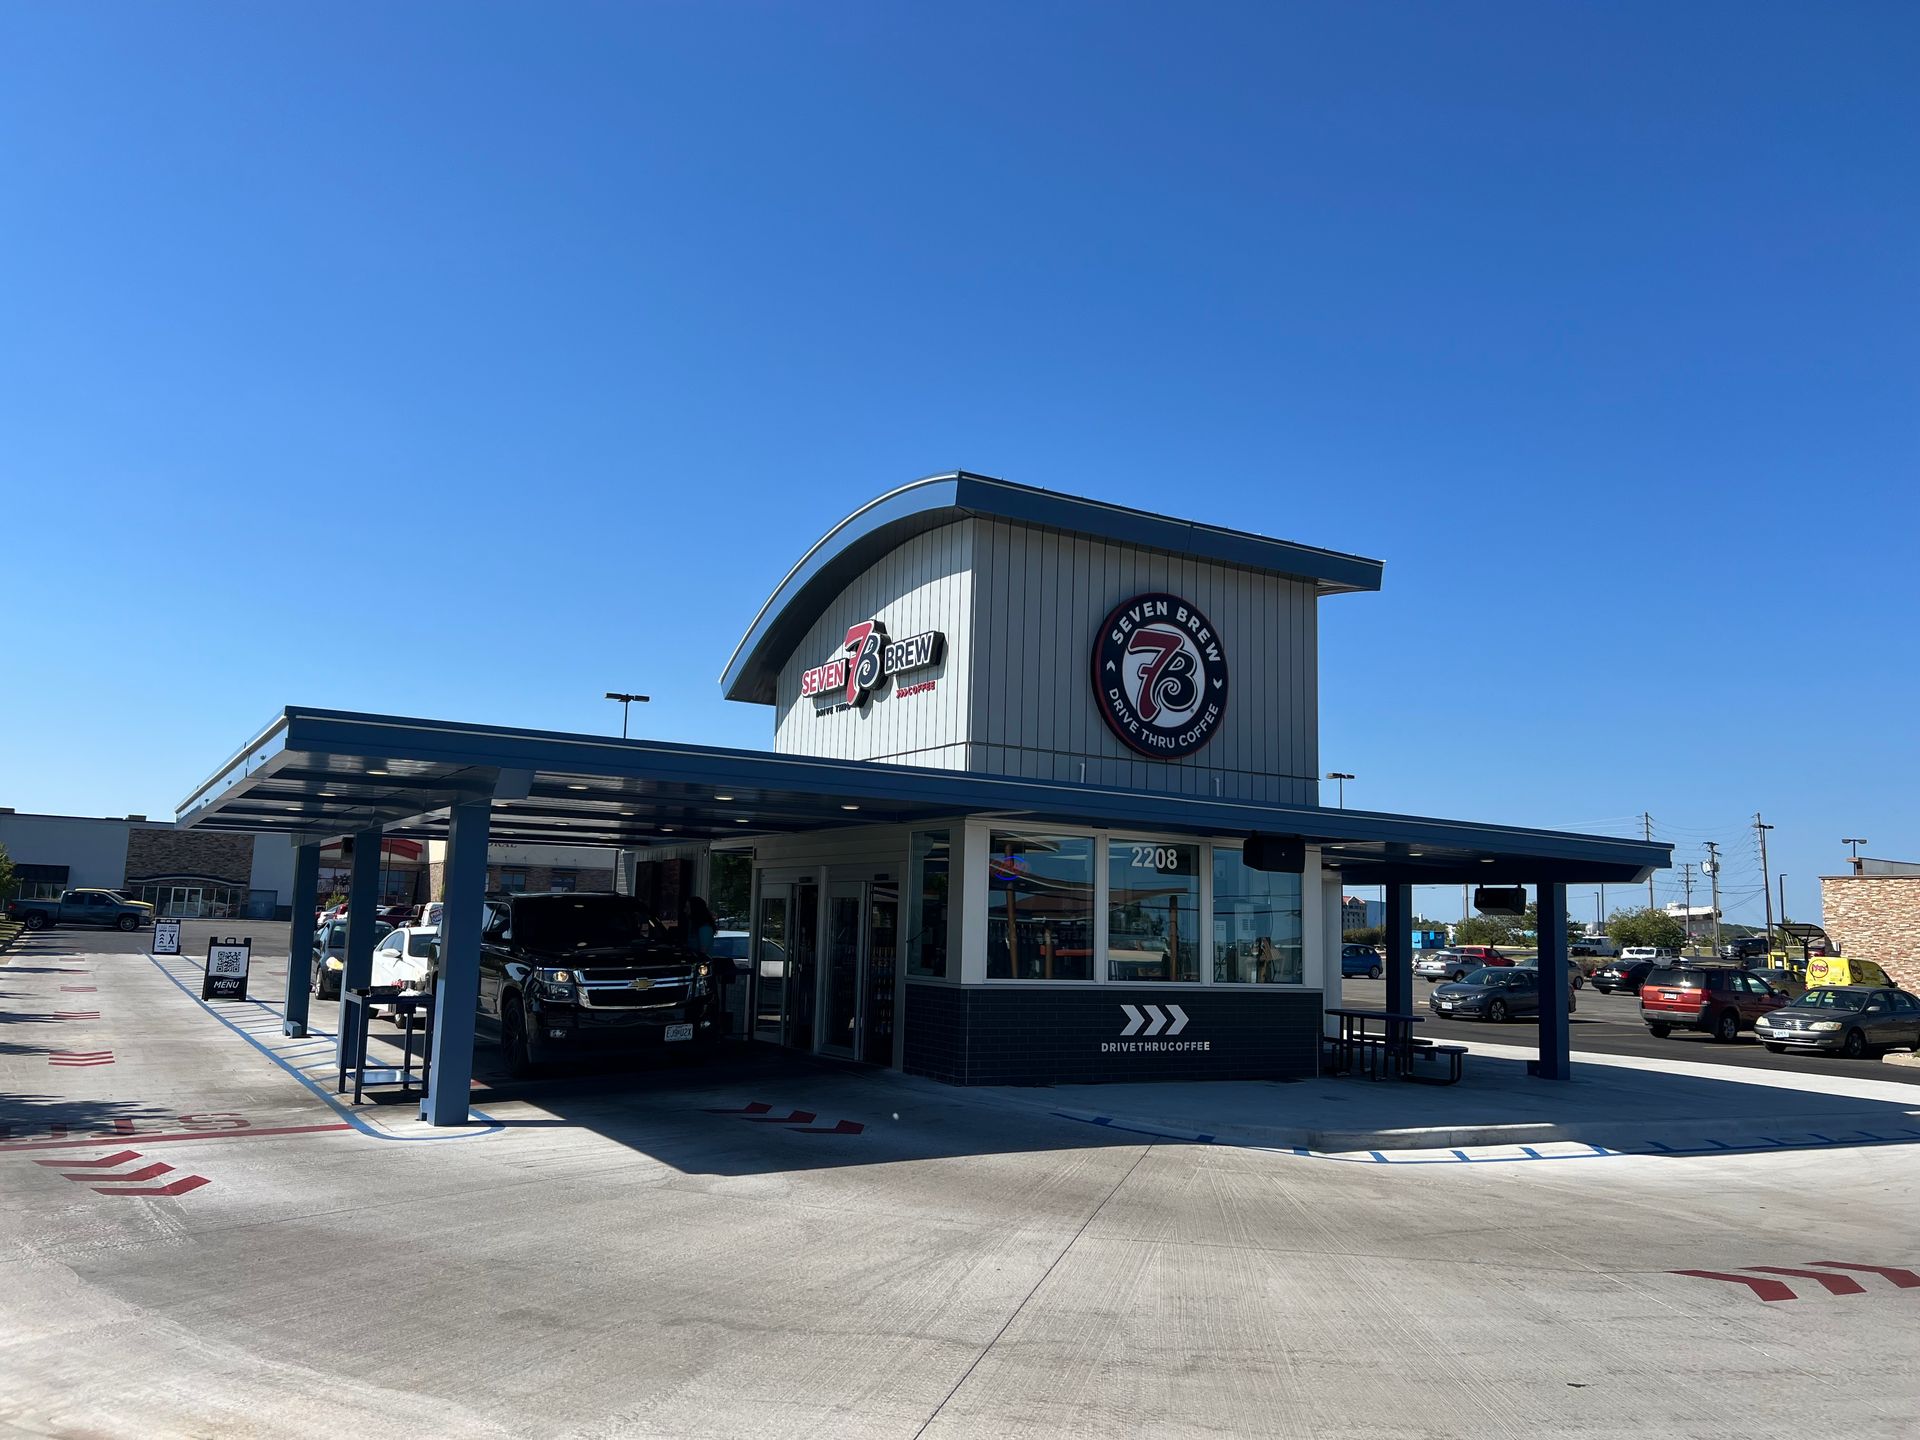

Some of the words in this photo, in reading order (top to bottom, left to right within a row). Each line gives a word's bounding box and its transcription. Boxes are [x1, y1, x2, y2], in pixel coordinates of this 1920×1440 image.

[1111, 601, 1168, 645] SEVEN
[1175, 606, 1221, 662] BREW
[802, 660, 846, 697] SEVEN
[884, 631, 934, 675] BREW
[908, 681, 936, 696] COFFEE
[1109, 688, 1140, 734] DRIVE
[1141, 729, 1175, 749] THRU
[1178, 703, 1219, 746] COFFEE
[1131, 846, 1178, 870] 2208
[213, 981, 240, 989] MENU
